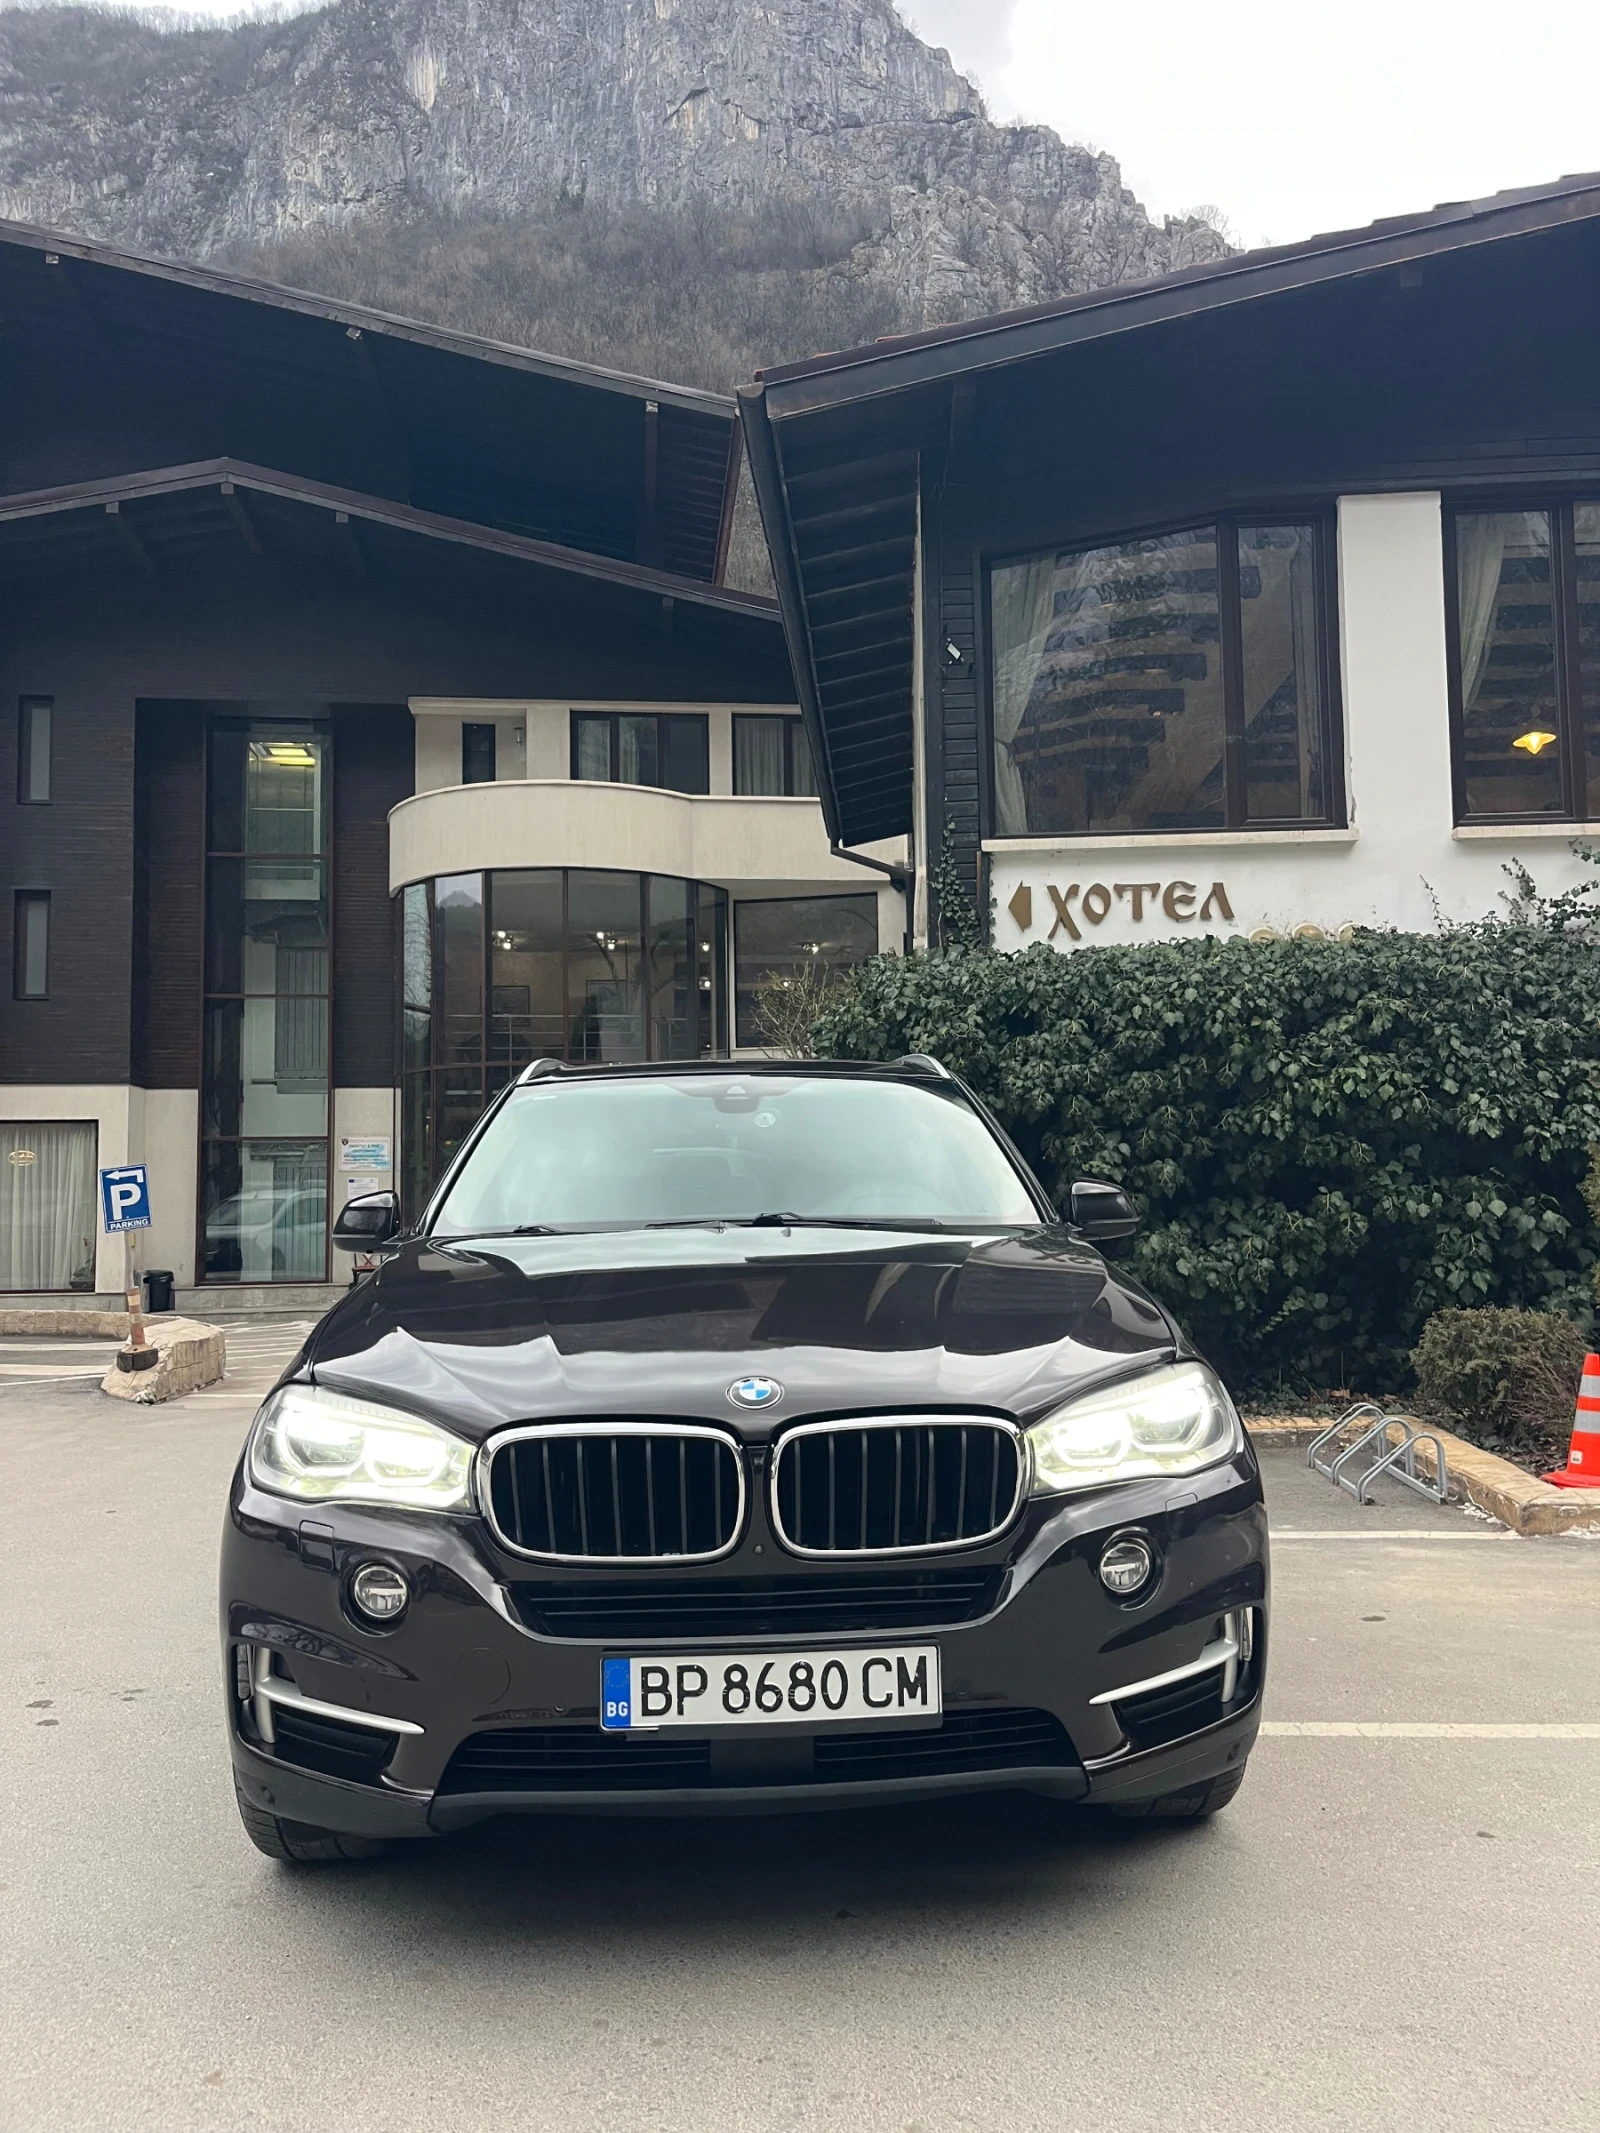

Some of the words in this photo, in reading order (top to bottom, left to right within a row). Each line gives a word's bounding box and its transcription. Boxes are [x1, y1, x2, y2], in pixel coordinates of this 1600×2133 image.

[1046, 880, 1235, 939] ХОТЕЛ
[110, 1183, 141, 1220] P
[110, 1218, 149, 1230] PARKING
[641, 1665, 708, 1716] BP
[722, 1659, 849, 1713] 8680
[862, 1655, 928, 1708] CM
[606, 1701, 629, 1718] BG
